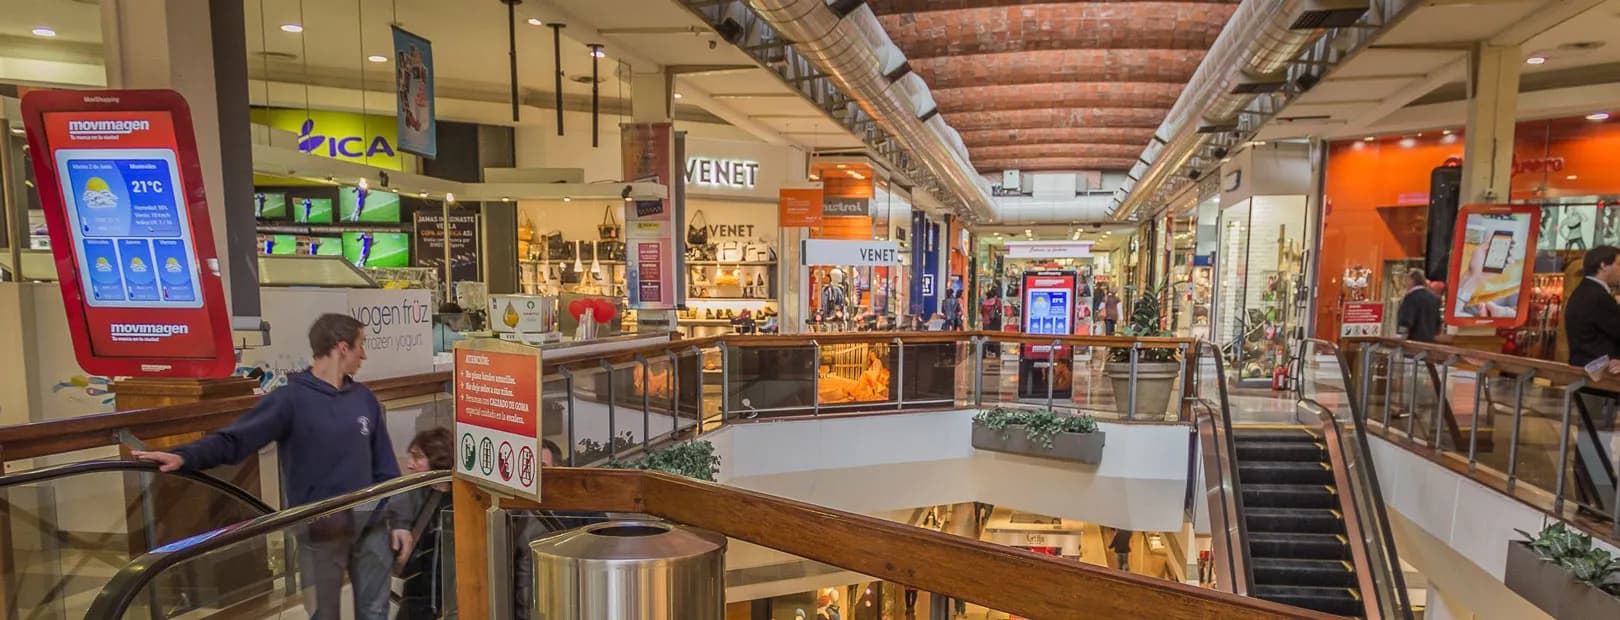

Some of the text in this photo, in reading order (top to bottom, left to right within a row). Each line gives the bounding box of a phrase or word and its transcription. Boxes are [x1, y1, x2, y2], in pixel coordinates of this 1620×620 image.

[69, 120, 149, 134] movimagen
[685, 159, 759, 186] VENET
[131, 180, 163, 193] 21°C
[708, 224, 755, 238] VENET
[860, 248, 895, 262] VENET
[351, 298, 430, 334] yogen früz
[111, 323, 188, 337] movimagen
